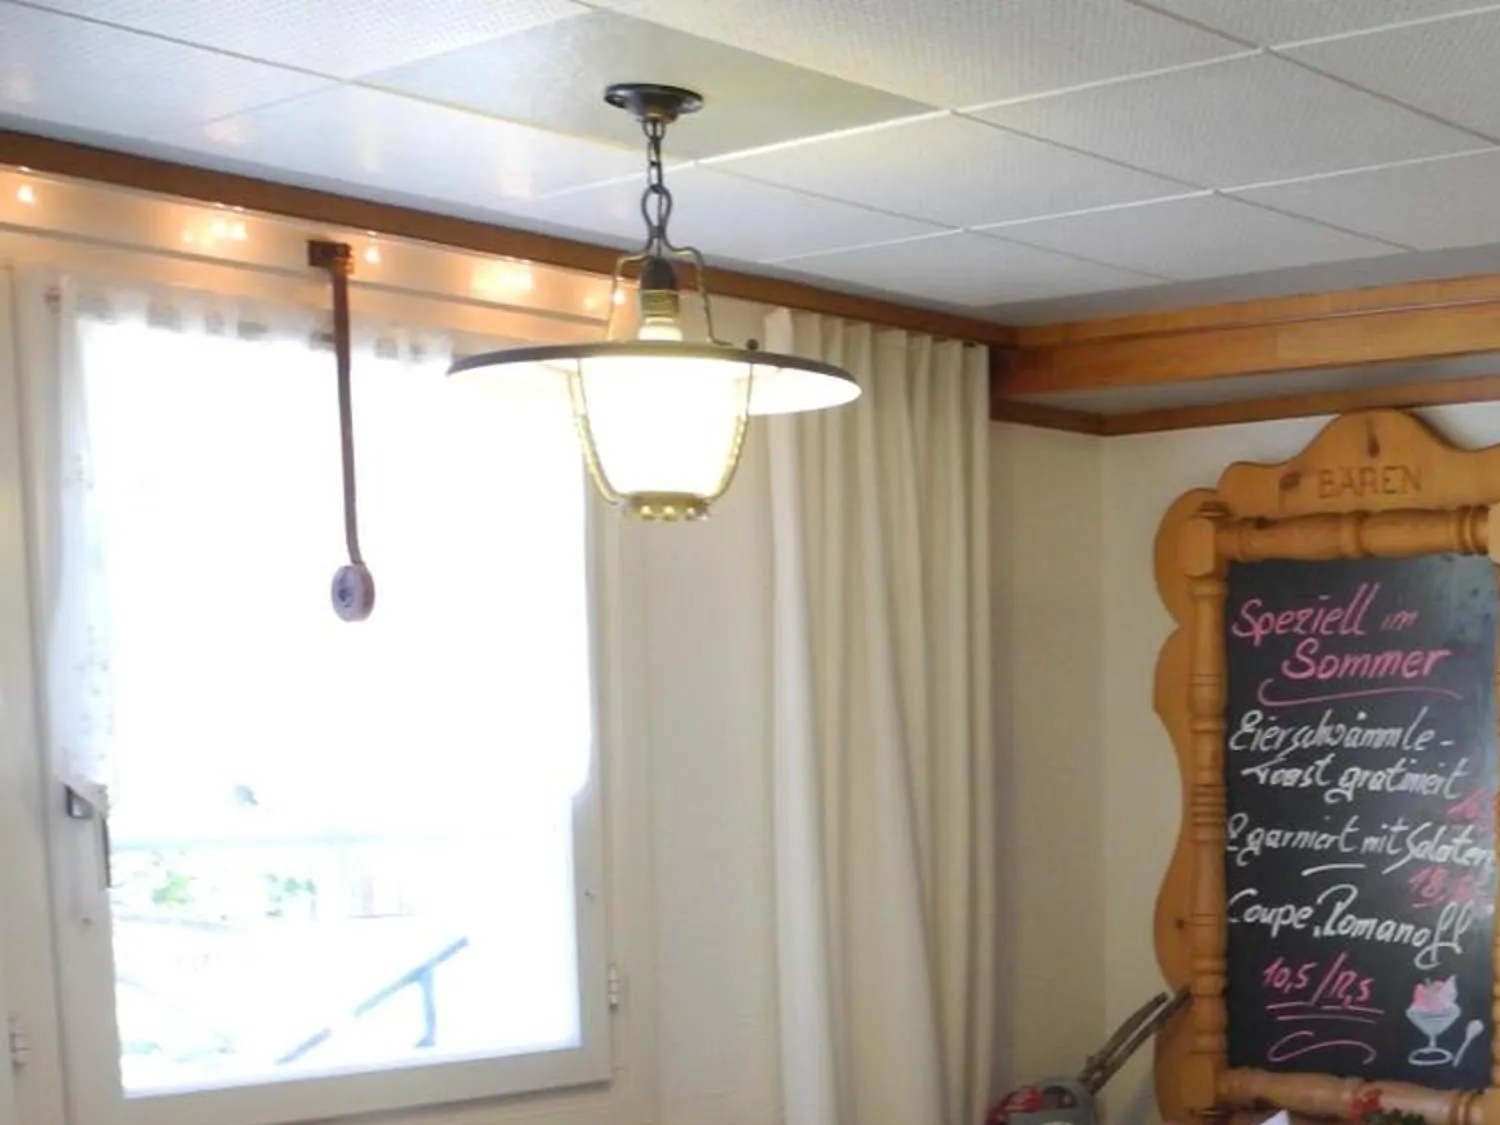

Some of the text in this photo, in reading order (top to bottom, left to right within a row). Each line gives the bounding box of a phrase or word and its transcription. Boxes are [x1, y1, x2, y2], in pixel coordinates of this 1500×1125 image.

[1231, 582, 1380, 647] Speziell
[1281, 637, 1452, 680] Sommer
[1227, 887, 1314, 938] Coupe
